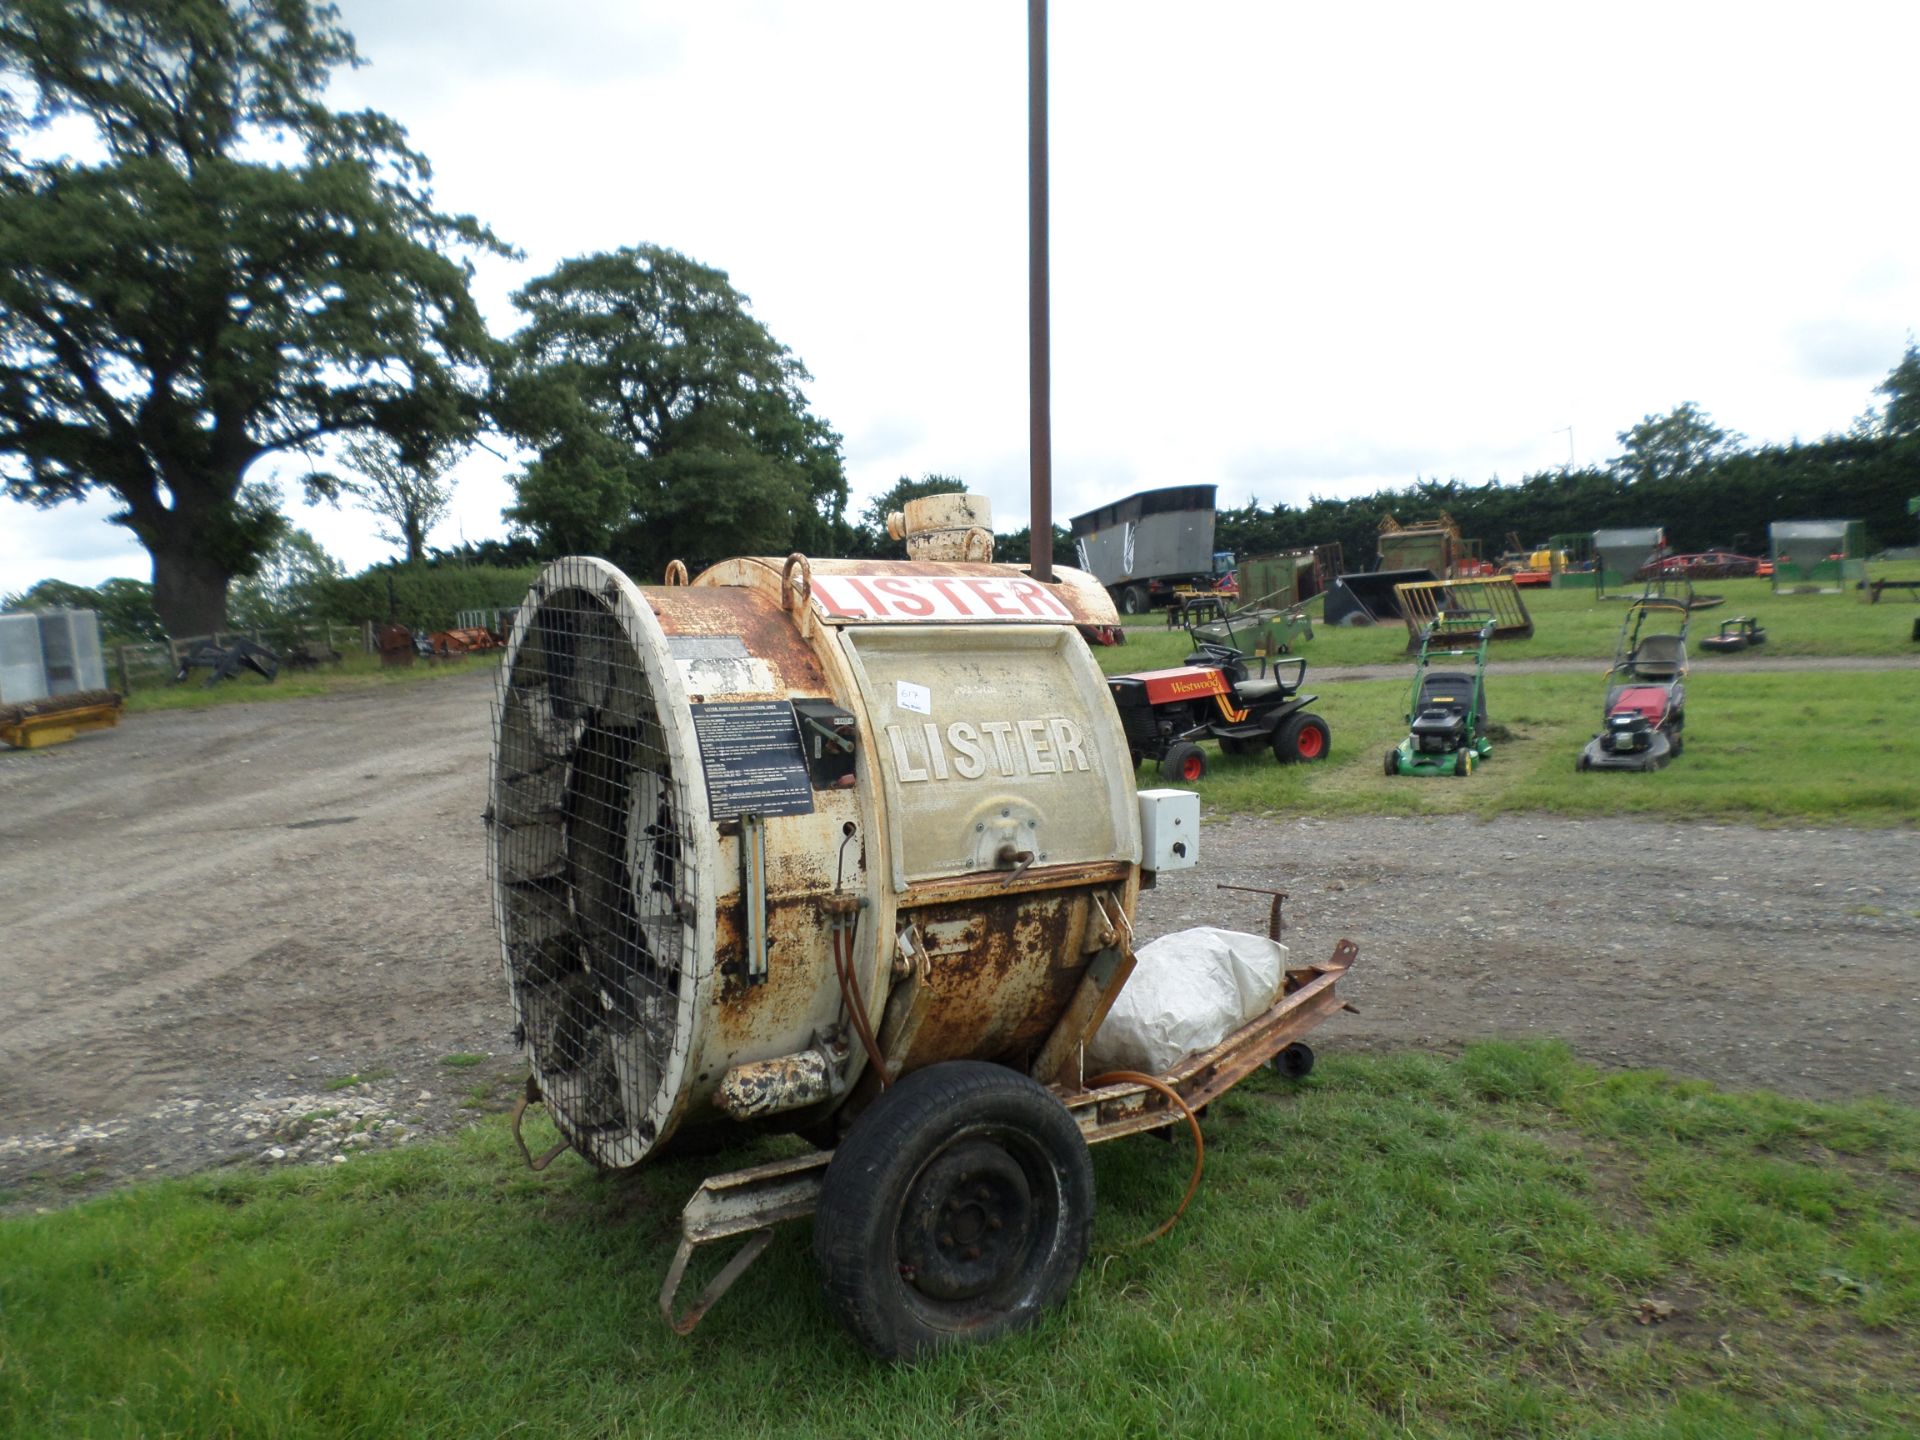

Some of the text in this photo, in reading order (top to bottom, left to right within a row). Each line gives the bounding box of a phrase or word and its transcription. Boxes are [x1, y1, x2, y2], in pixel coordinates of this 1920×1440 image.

[811, 577, 1067, 617] LISTER
[1171, 680, 1219, 693] Westwood
[885, 719, 1091, 783] LISTER
